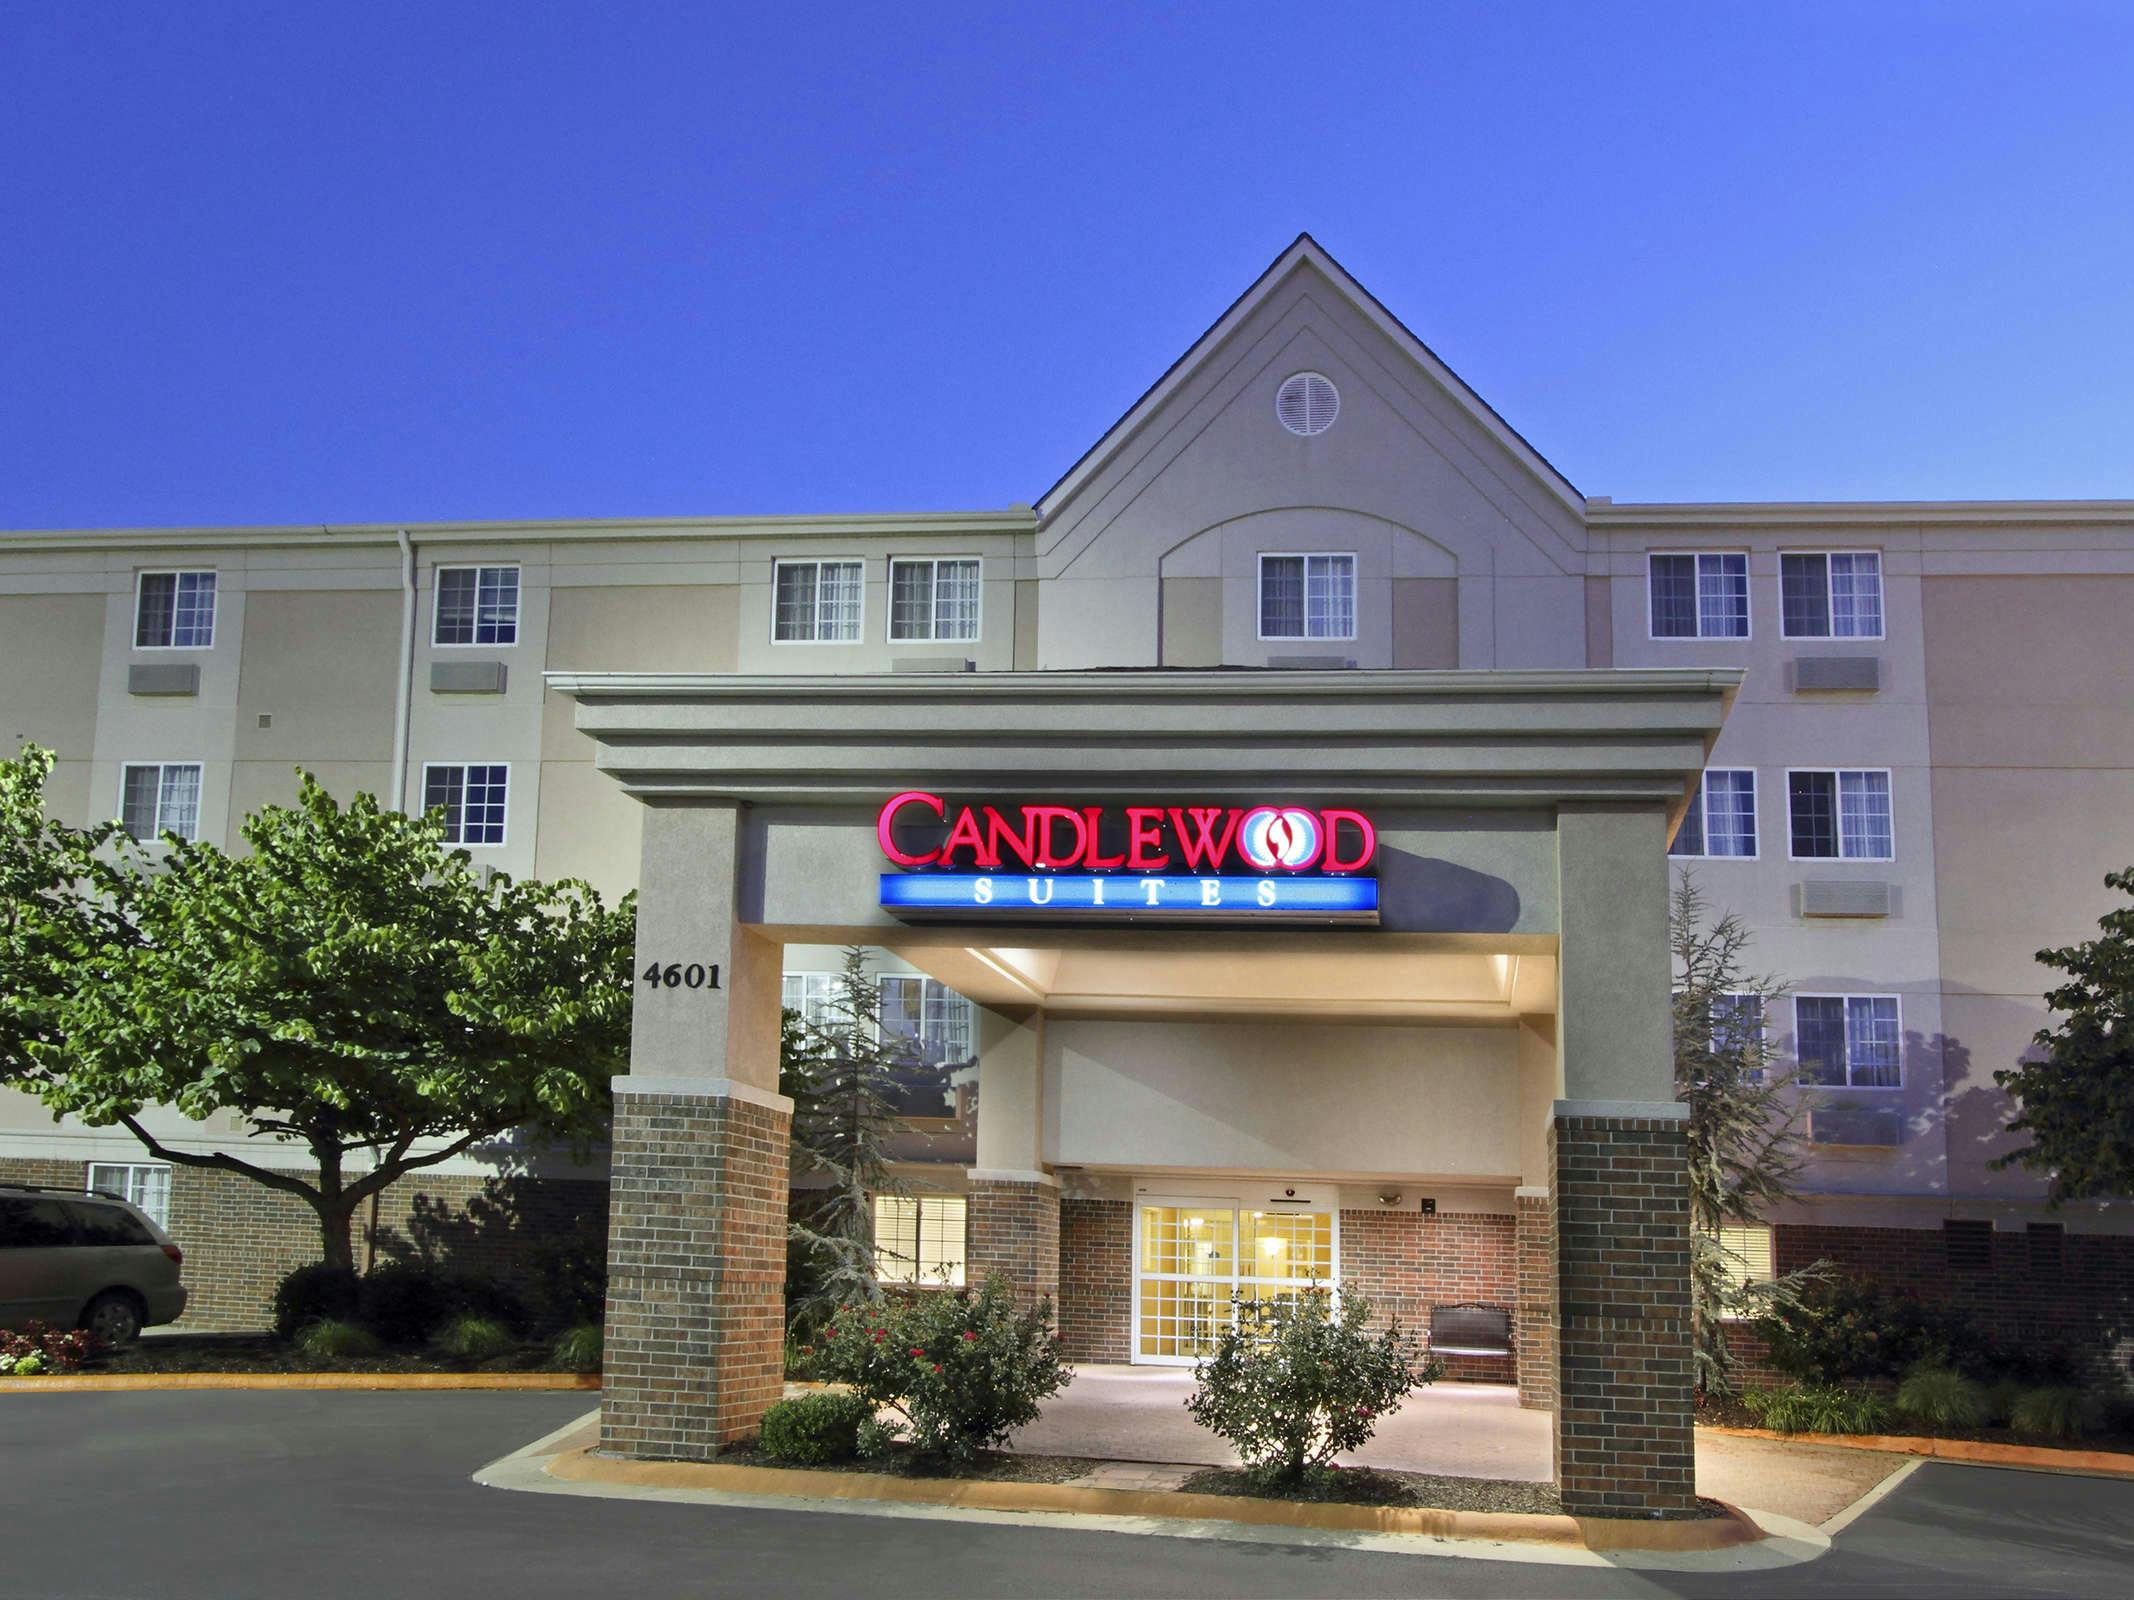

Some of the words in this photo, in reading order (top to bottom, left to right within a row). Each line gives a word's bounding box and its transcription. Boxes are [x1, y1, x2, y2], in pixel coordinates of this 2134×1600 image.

[877, 791, 1377, 871] CANDLEWOOD
[973, 877, 1277, 907] SUITES
[642, 961, 721, 990] 4601
